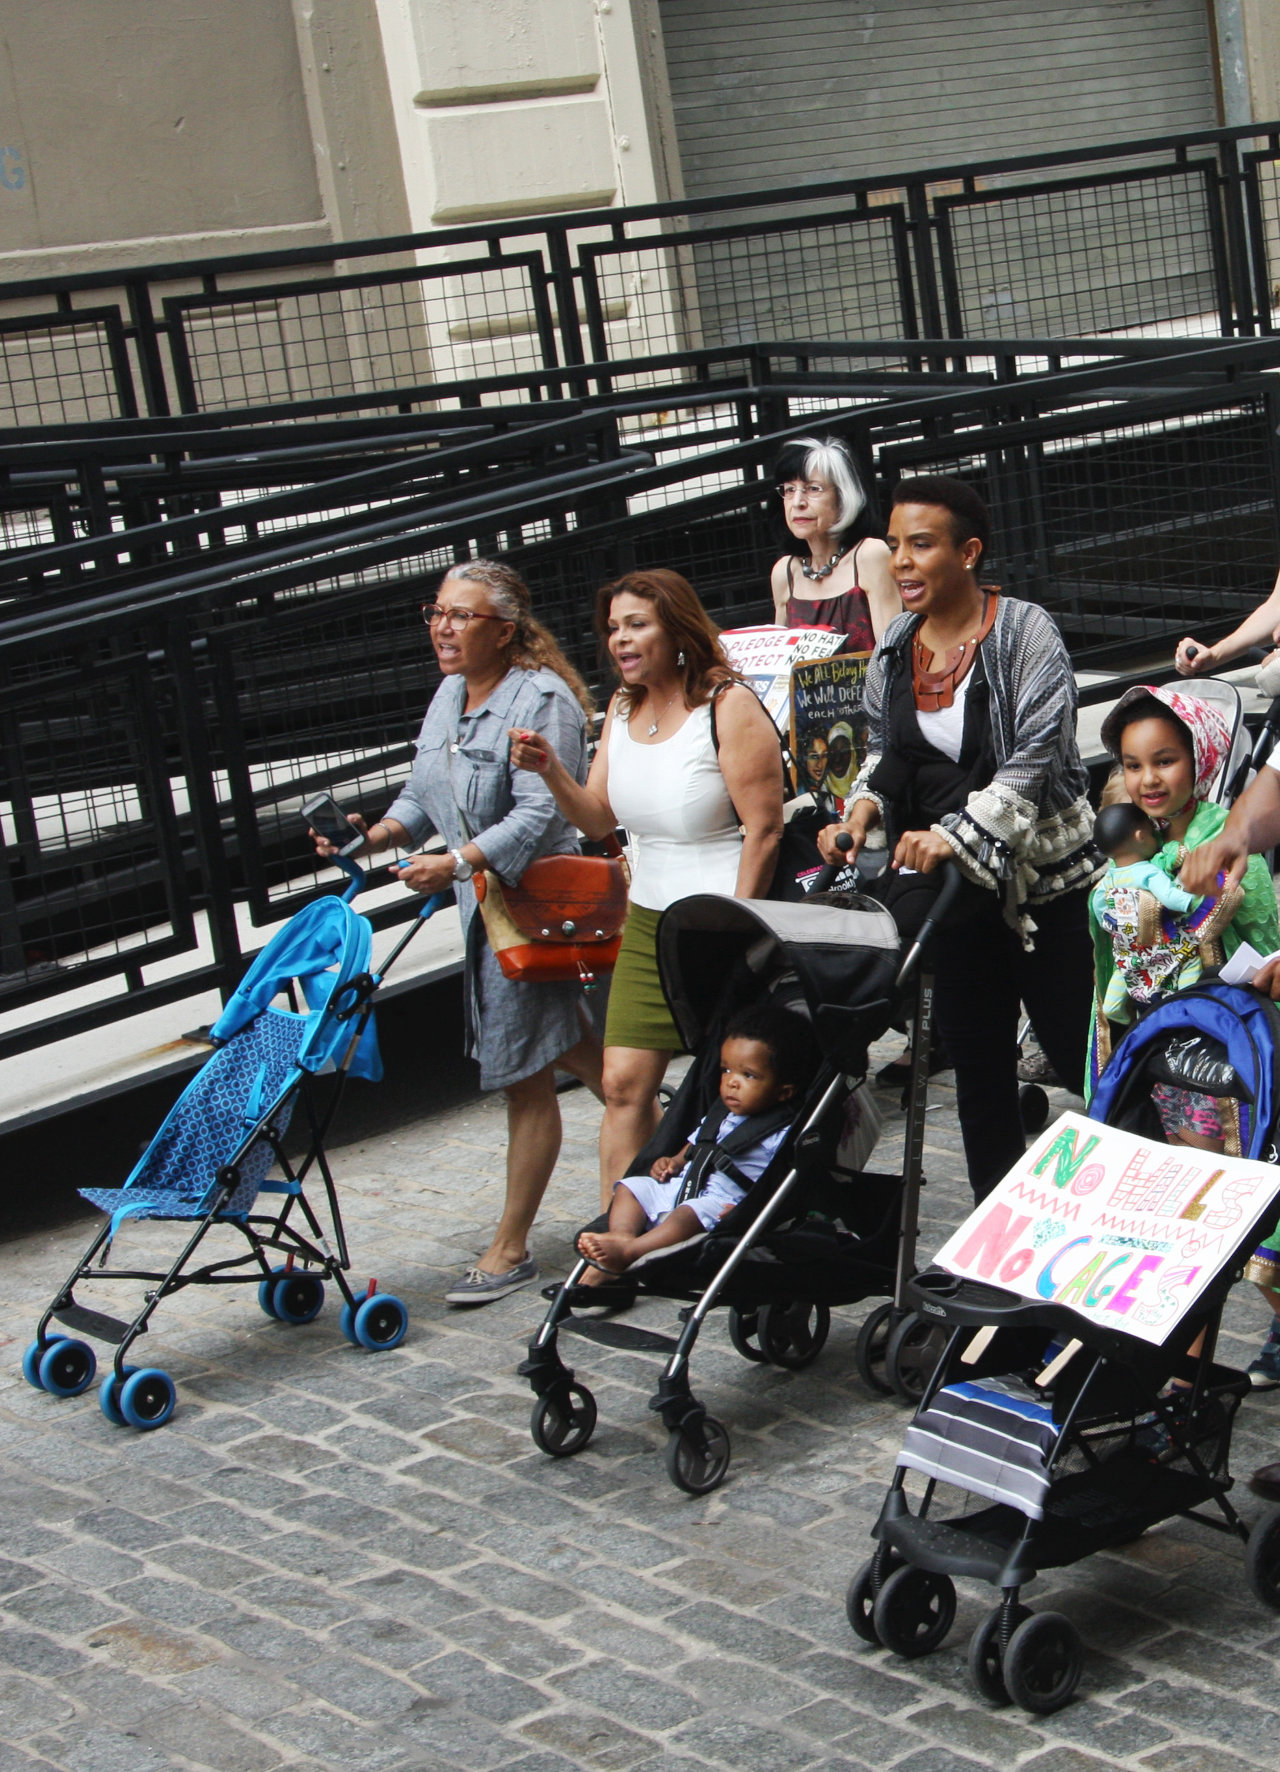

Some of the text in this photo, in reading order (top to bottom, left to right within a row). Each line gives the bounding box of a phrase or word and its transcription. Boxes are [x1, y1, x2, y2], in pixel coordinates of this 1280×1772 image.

[729, 635, 786, 652] PLEDGE
[800, 632, 817, 642] NO
[793, 644, 810, 655] NO
[797, 670, 813, 689] We
[830, 660, 858, 685] Belong
[796, 689, 813, 709] We
[912, 987, 934, 1161] LITEWAY PLUS
[1036, 1235, 1203, 1327] CAGES
